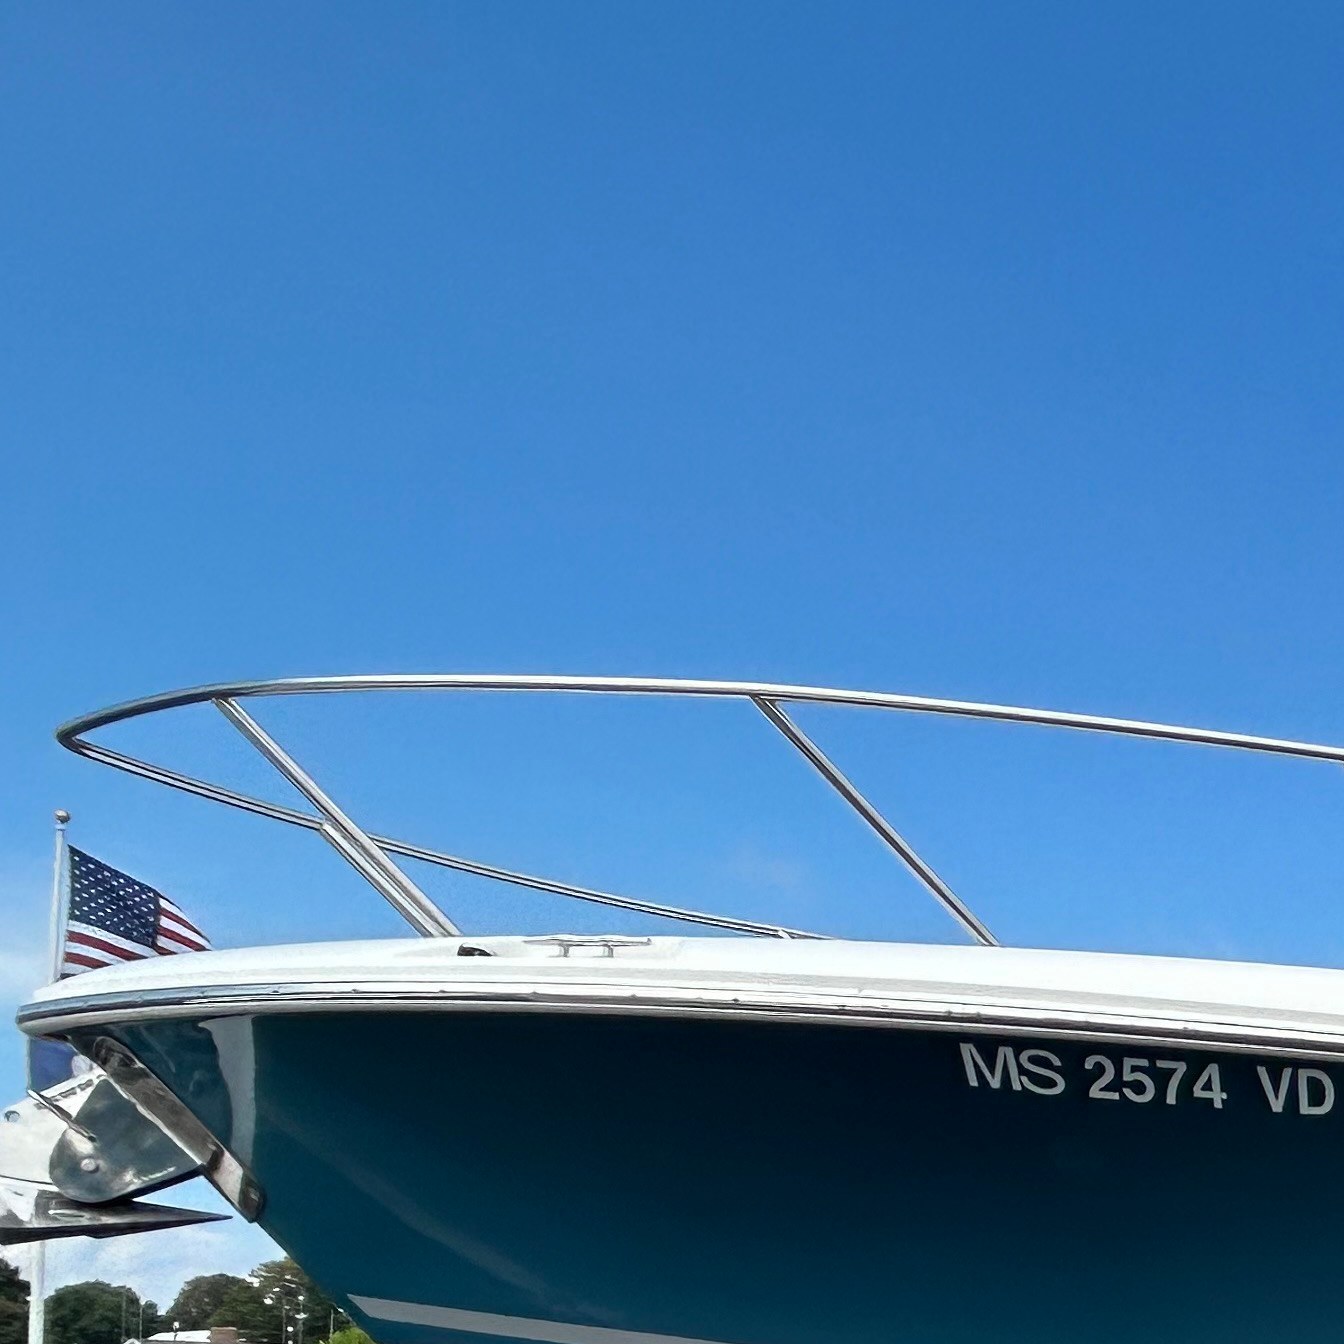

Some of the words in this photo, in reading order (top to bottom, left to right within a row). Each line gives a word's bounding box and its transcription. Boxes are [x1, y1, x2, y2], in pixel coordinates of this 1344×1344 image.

[959, 1042, 1066, 1096] MS
[1084, 1055, 1228, 1110] 2574
[1257, 1064, 1336, 1116] VD
